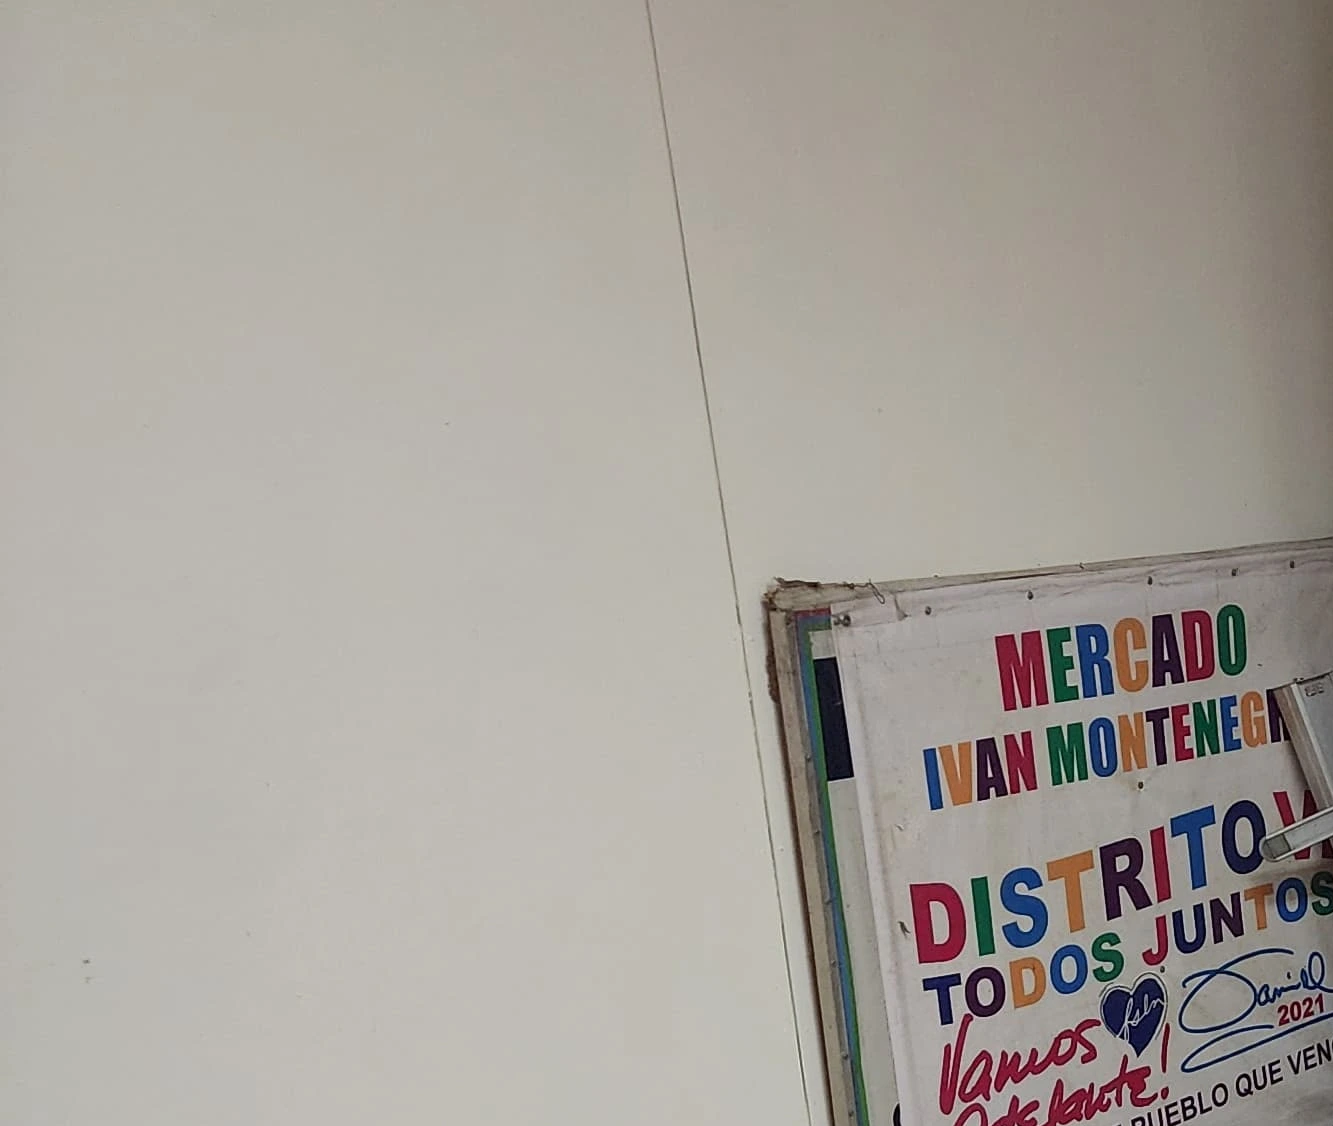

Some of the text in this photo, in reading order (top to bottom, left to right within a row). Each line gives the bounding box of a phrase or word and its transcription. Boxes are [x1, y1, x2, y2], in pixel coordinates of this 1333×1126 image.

[995, 604, 1246, 712] MERCADO
[923, 735, 1038, 811] IVAN
[909, 799, 1266, 964] DISTRITO
[923, 932, 1124, 1025] TODOS
[1277, 993, 1325, 1027] 2021
[940, 1013, 1101, 1114] Vamos
[1235, 1060, 1283, 1097] QUE
